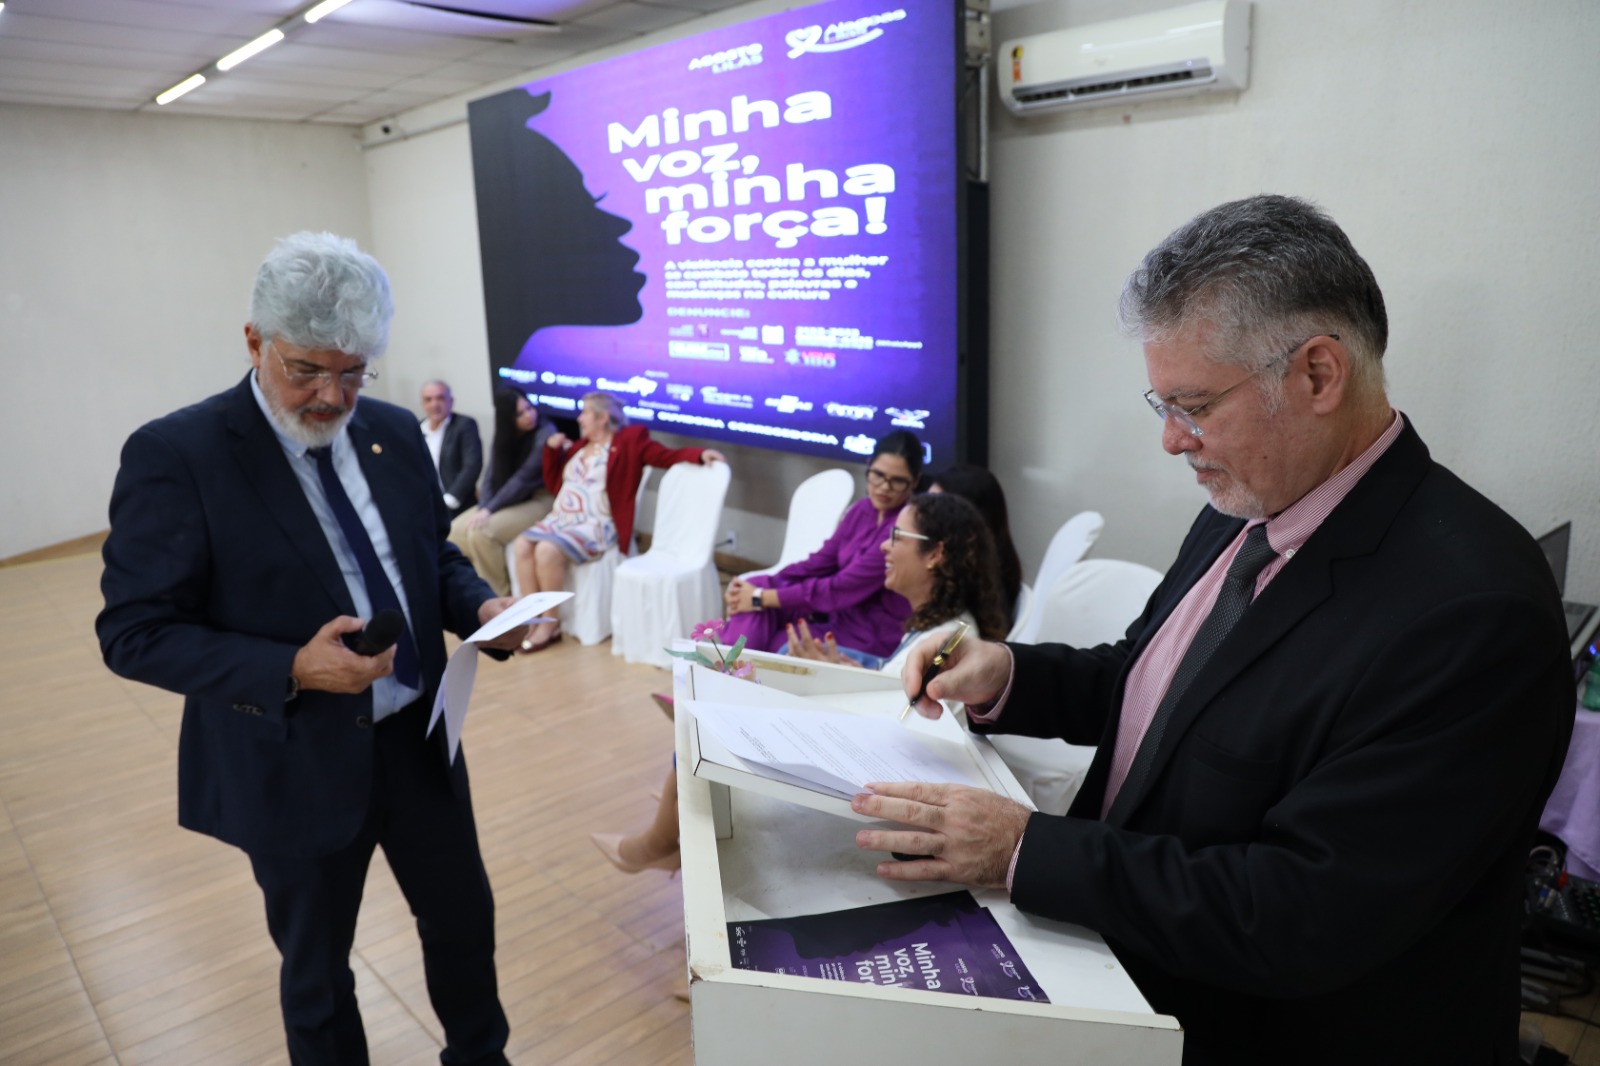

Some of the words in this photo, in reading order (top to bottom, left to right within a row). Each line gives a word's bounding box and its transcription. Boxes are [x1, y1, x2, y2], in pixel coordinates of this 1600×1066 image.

[607, 91, 832, 154] Minha
[622, 142, 760, 183] voz,
[645, 162, 895, 214] minha
[661, 196, 888, 248] força!
[894, 947, 914, 978] voz,
[911, 942, 942, 990] Minha
